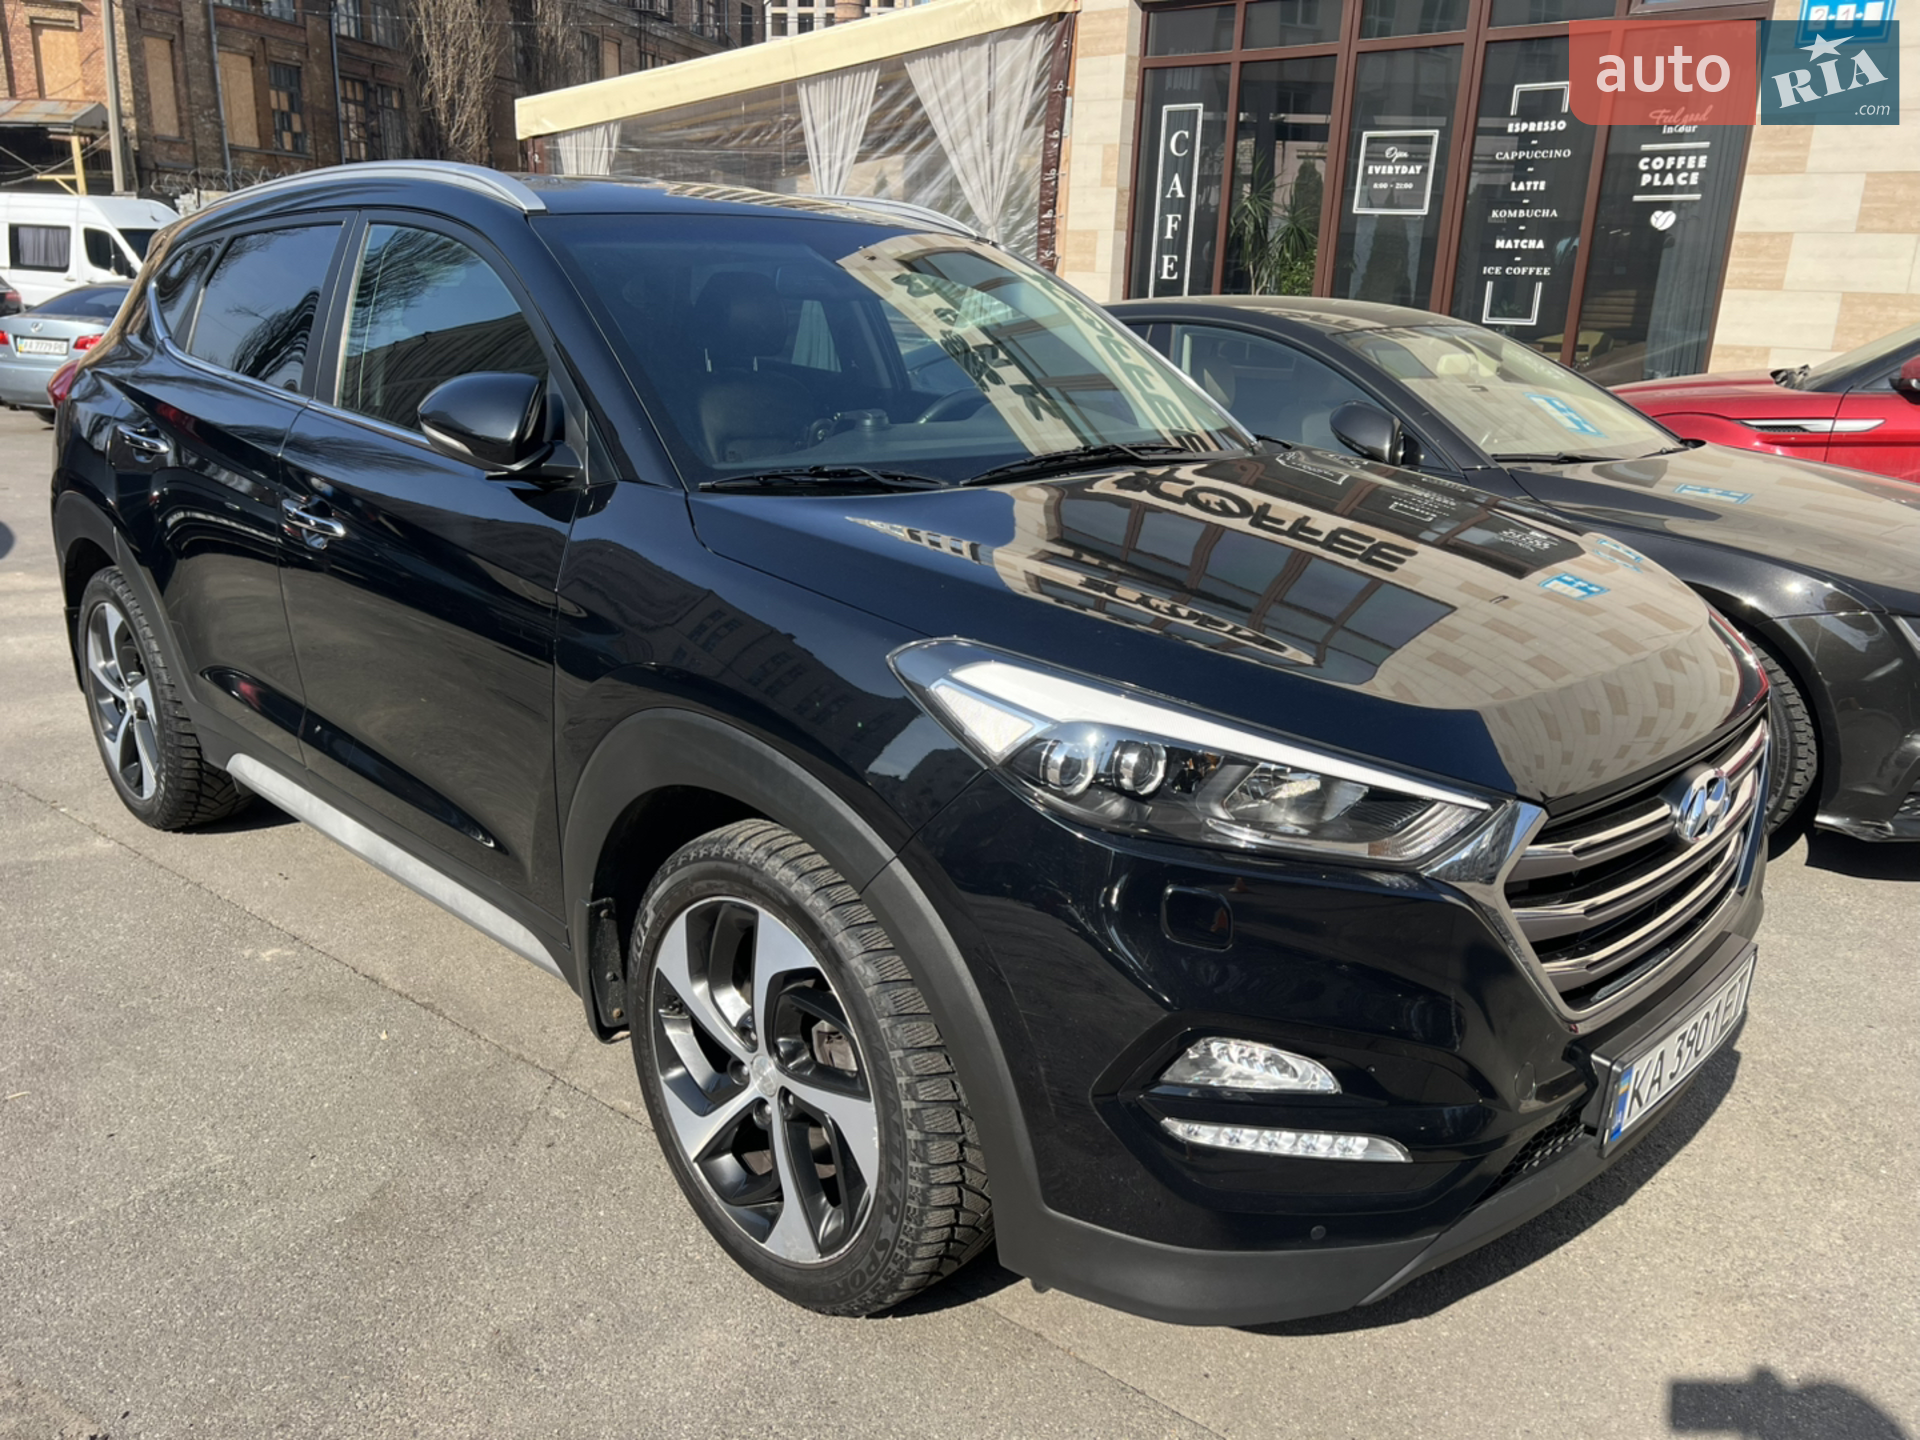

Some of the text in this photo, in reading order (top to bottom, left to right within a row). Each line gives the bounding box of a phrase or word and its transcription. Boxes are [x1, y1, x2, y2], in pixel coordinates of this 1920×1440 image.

[1507, 120, 1567, 133] ESPRESSO
[1495, 148, 1572, 160] CAPPUCCINO
[1638, 155, 1708, 171] COFFEE
[1367, 165, 1423, 175] EVERYDAY
[1640, 172, 1700, 187] PLACE
[1510, 180, 1546, 192] LATTE
[1160, 130, 1189, 280] CAFE
[1491, 208, 1558, 218] KOMBUCHA
[1495, 239, 1545, 249] MATCHA
[1482, 266, 1552, 276] ICE COFFEE
